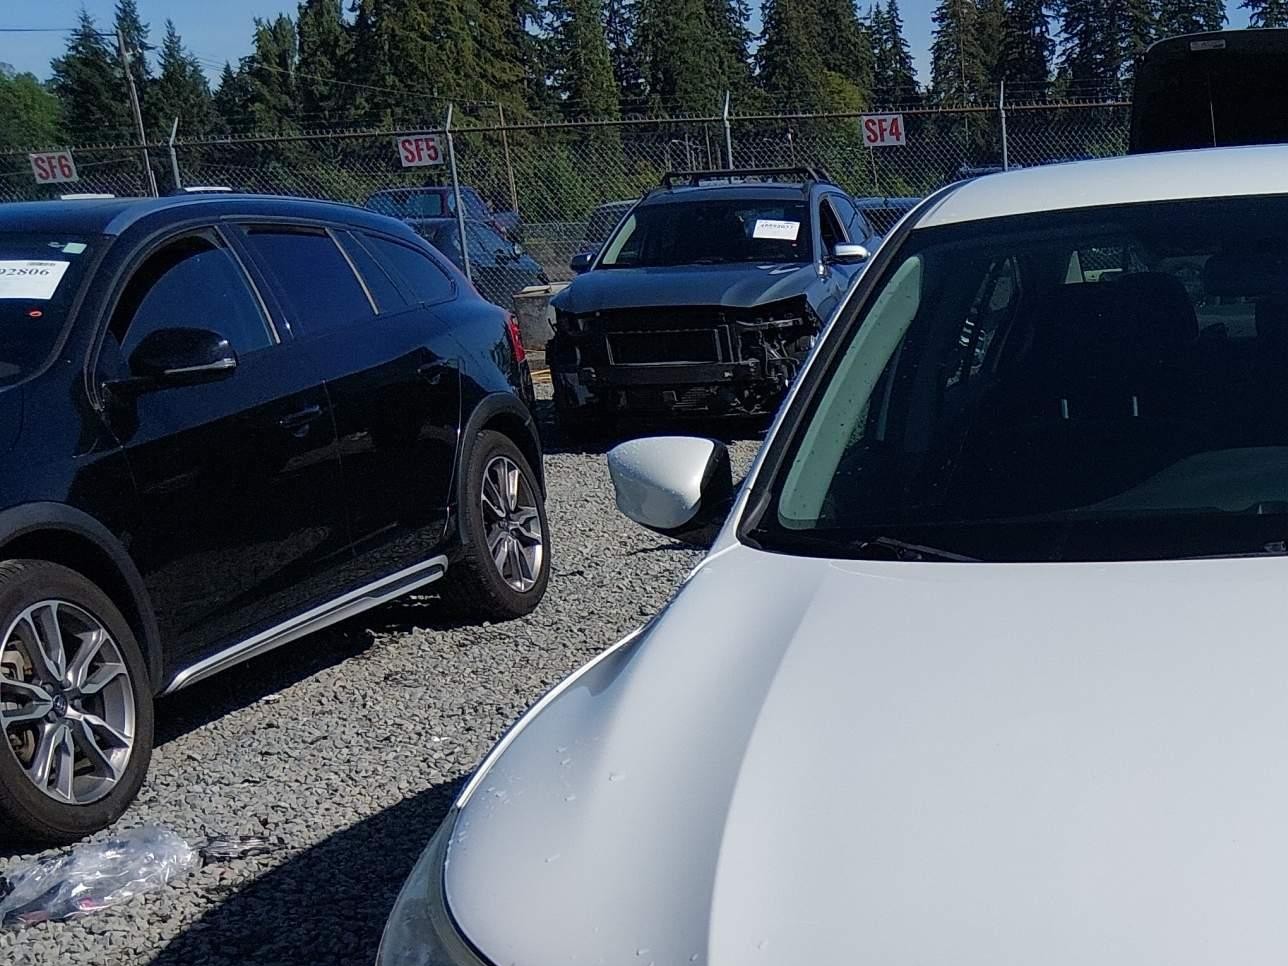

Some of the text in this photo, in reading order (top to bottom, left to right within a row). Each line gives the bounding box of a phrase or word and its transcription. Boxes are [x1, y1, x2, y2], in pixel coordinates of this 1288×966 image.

[864, 116, 902, 144] SF4
[401, 138, 439, 163] SF5
[34, 155, 73, 180] SF6
